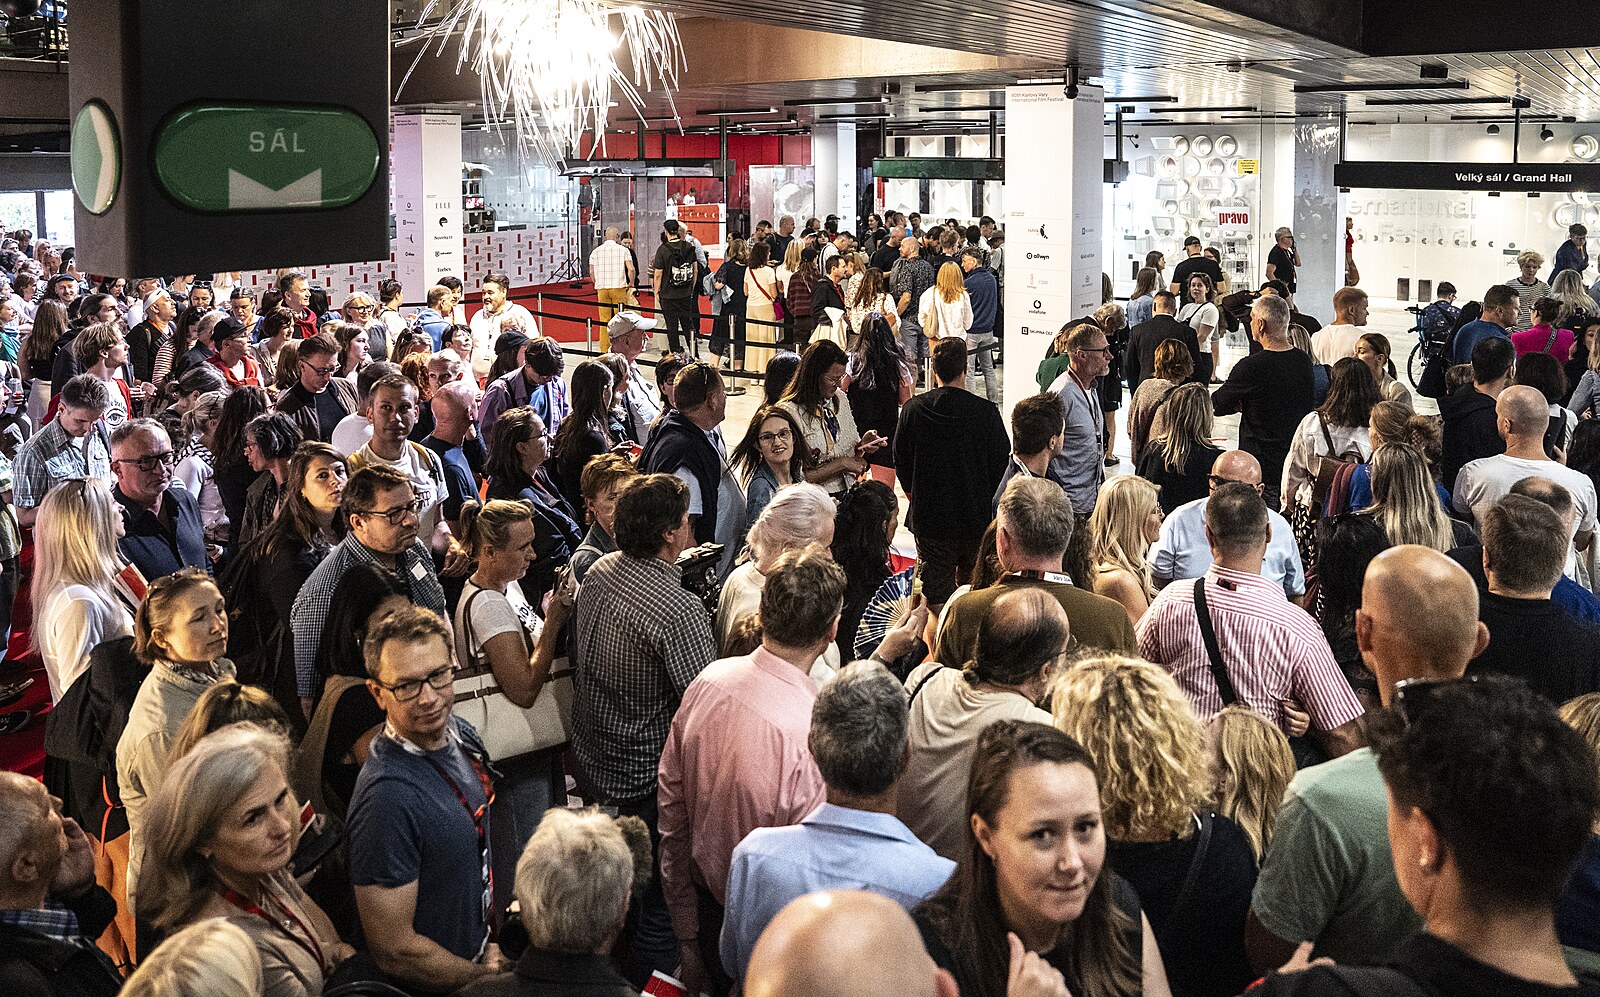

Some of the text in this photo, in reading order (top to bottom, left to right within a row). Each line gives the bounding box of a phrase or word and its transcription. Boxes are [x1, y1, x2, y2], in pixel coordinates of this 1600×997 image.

[249, 127, 305, 152] SÁL
[1455, 172, 1572, 183] Velký sál / Grand Hall
[1348, 197, 1476, 219] ernational
